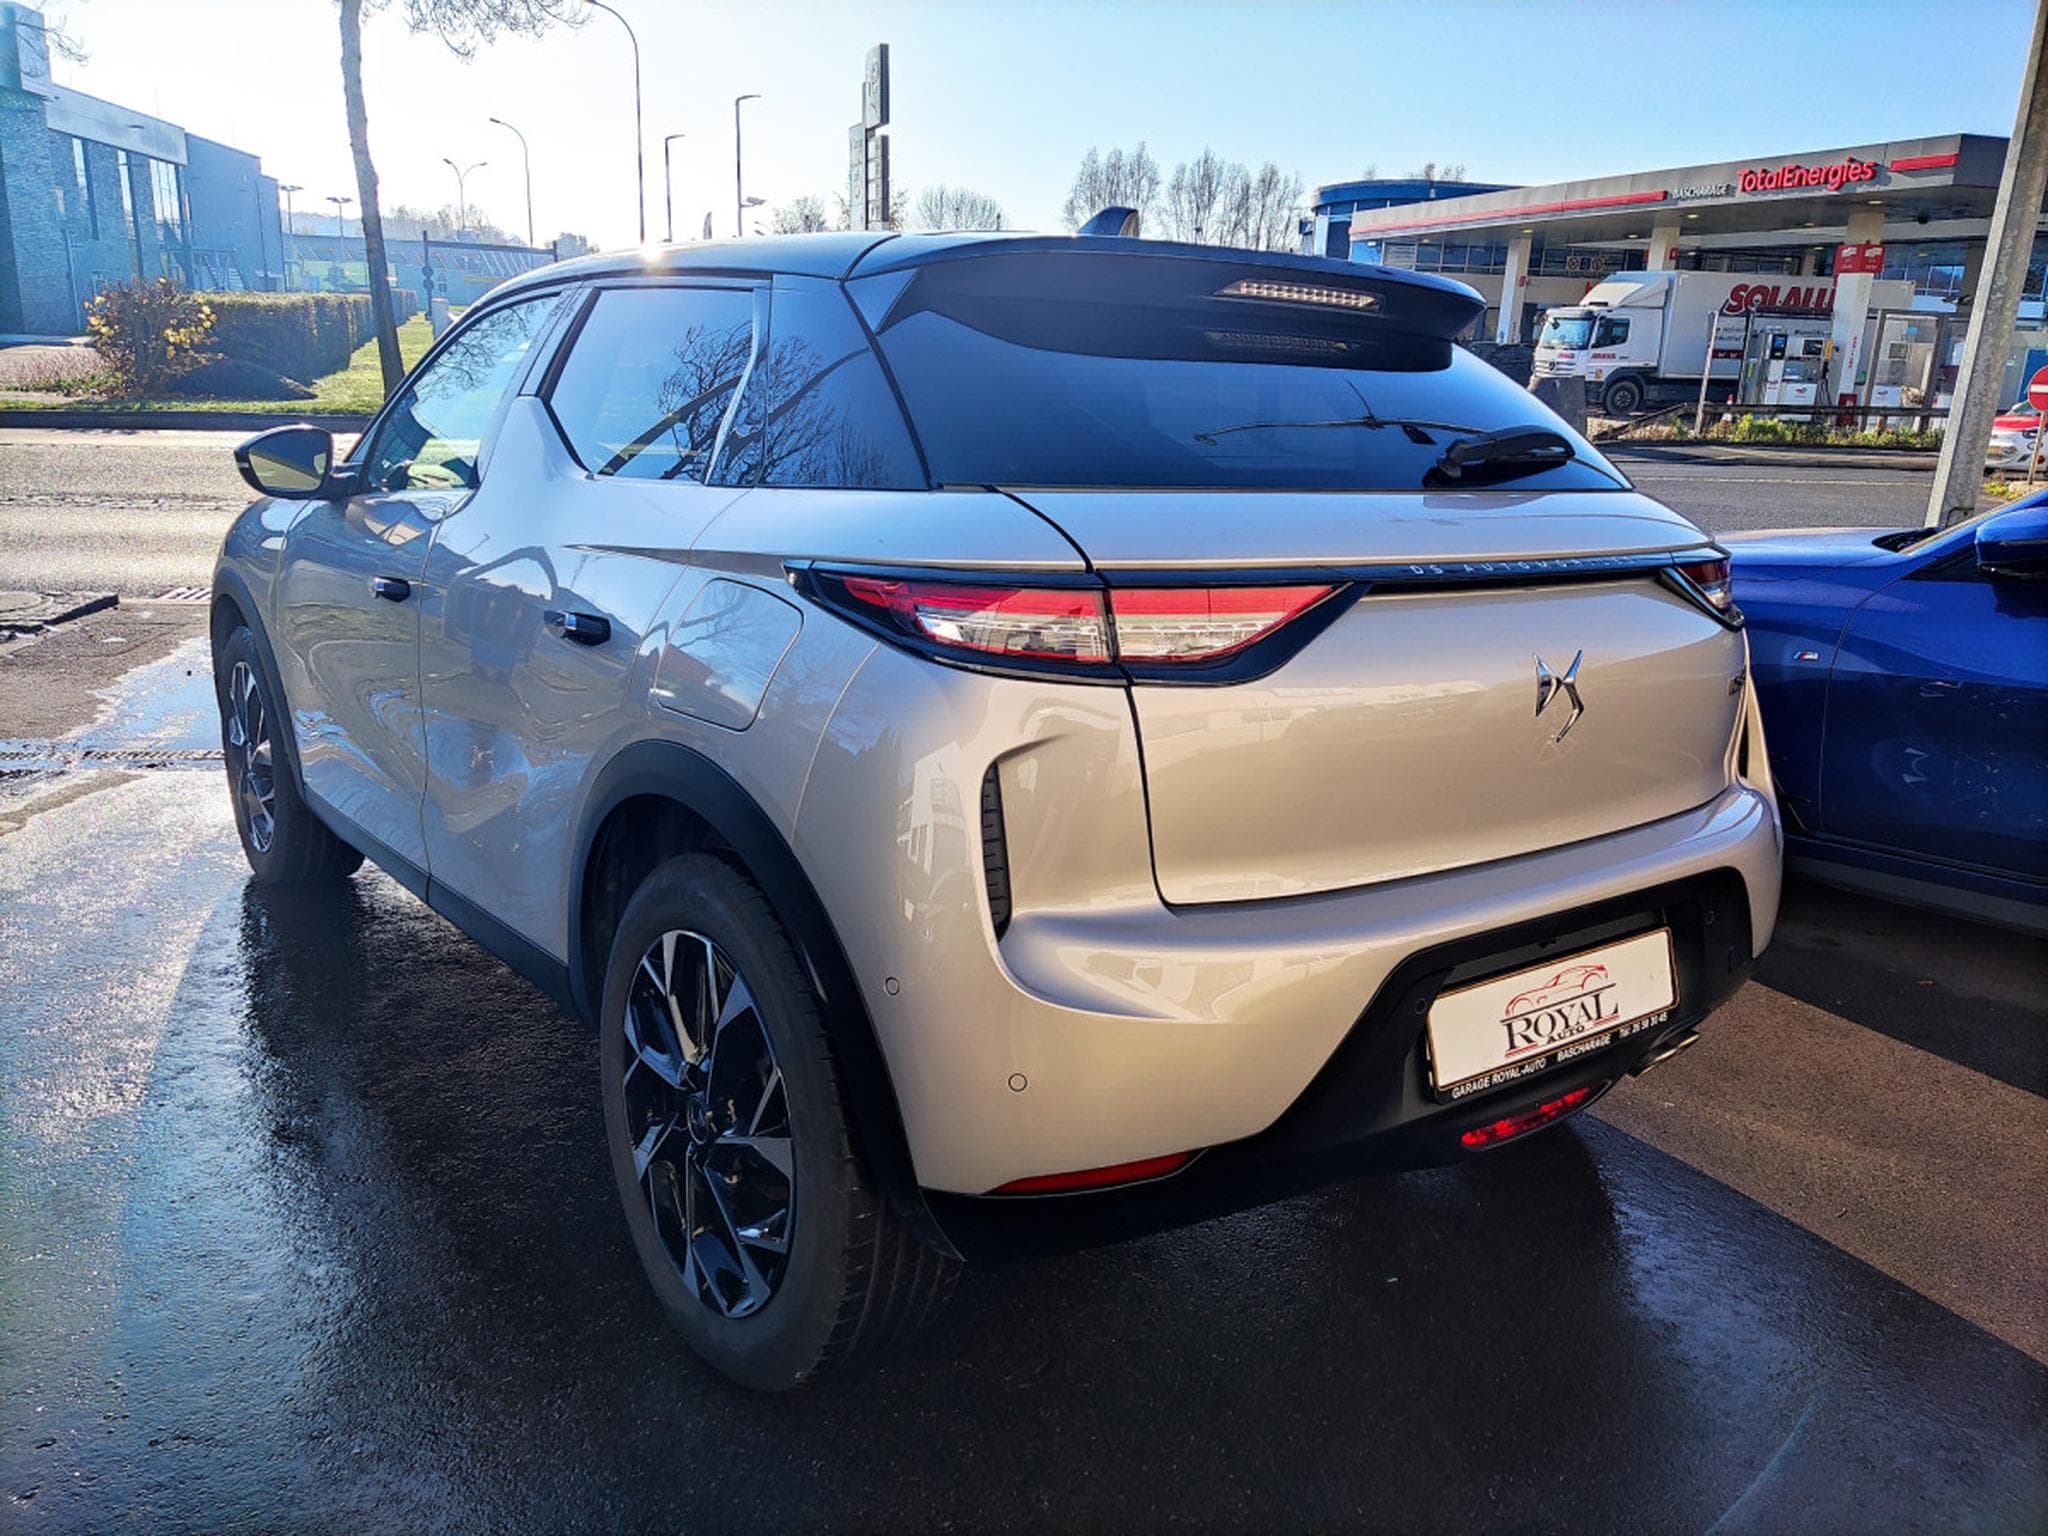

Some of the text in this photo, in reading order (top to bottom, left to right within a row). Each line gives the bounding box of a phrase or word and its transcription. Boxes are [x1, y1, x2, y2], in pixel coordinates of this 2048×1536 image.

[1736, 157, 1877, 192] TotalEnergies
[1409, 564, 1443, 575] DS
[1502, 991, 1619, 1052] ROYAL
[1547, 1025, 1585, 1044] AUTO
[1452, 1076, 1491, 1099] GARAGE
[1491, 1058, 1548, 1085] ROYAL-AUTO
[1557, 1034, 1612, 1062] BASCHARAGE
